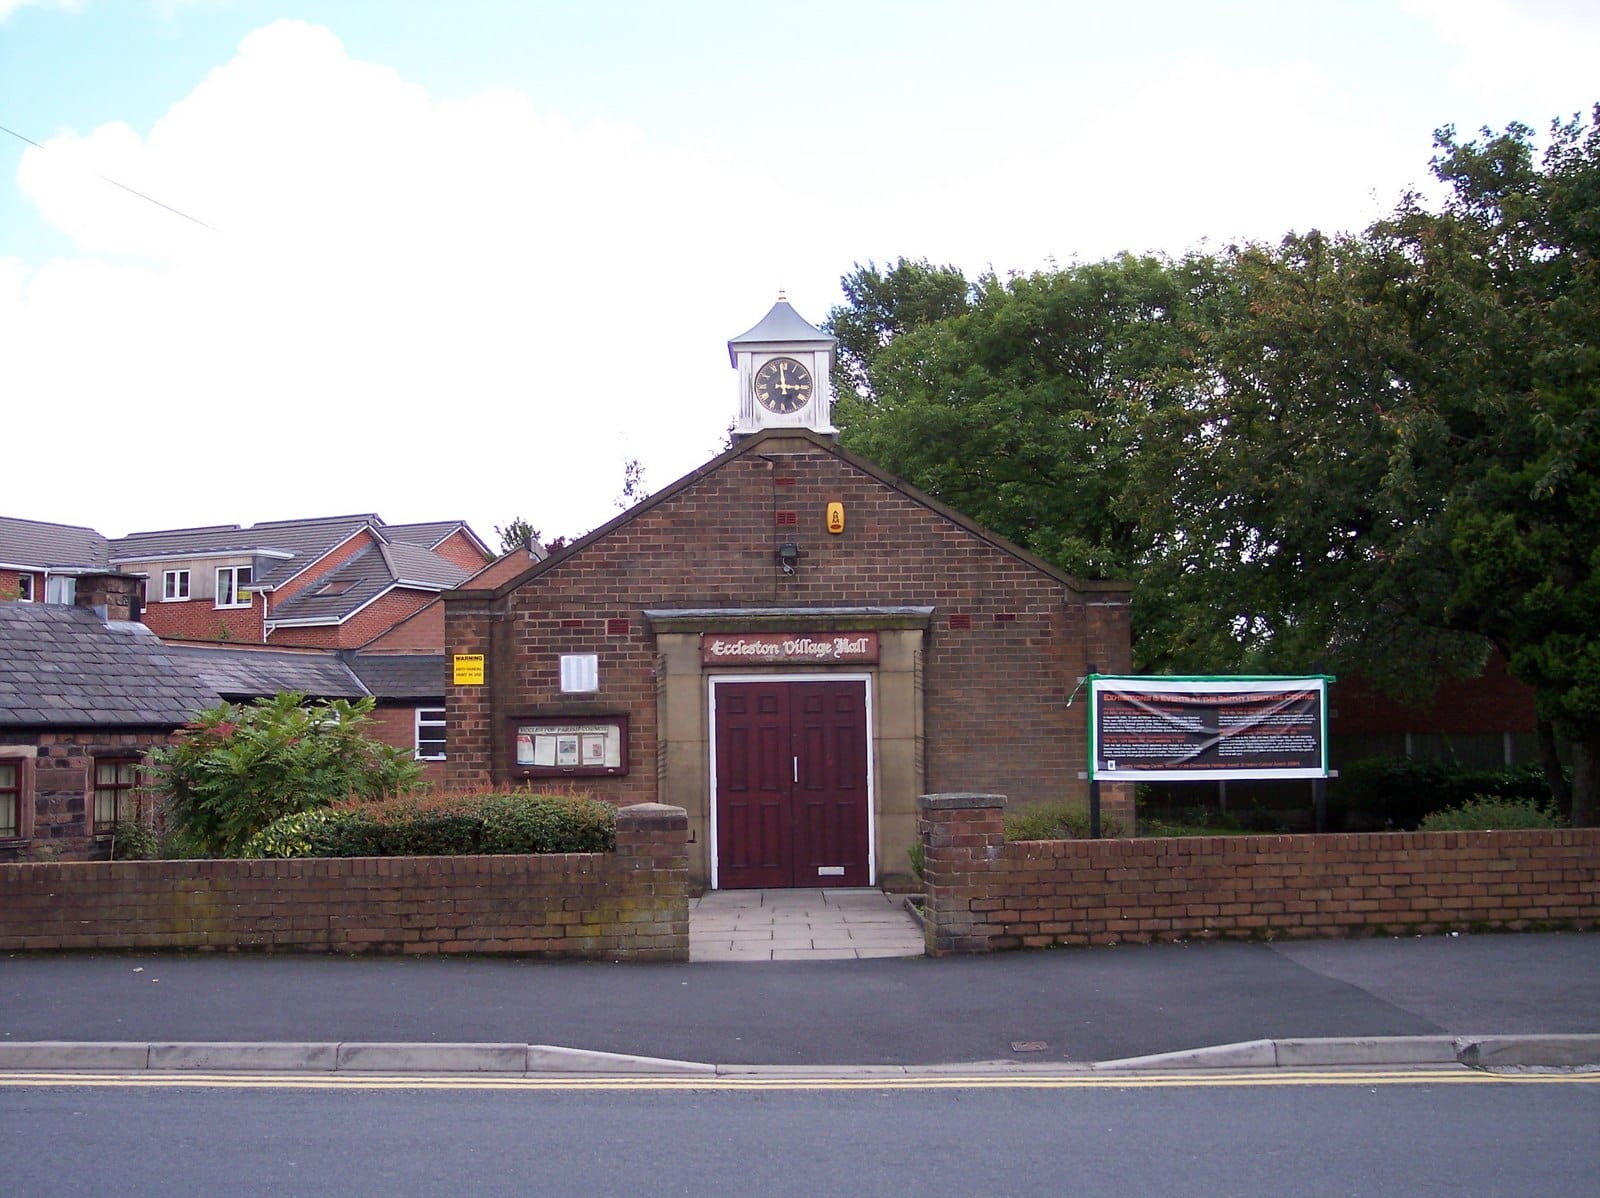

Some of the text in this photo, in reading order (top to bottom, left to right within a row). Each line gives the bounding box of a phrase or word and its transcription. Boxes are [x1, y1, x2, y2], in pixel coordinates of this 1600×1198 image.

[711, 637, 869, 658] Eccleston Village Hall
